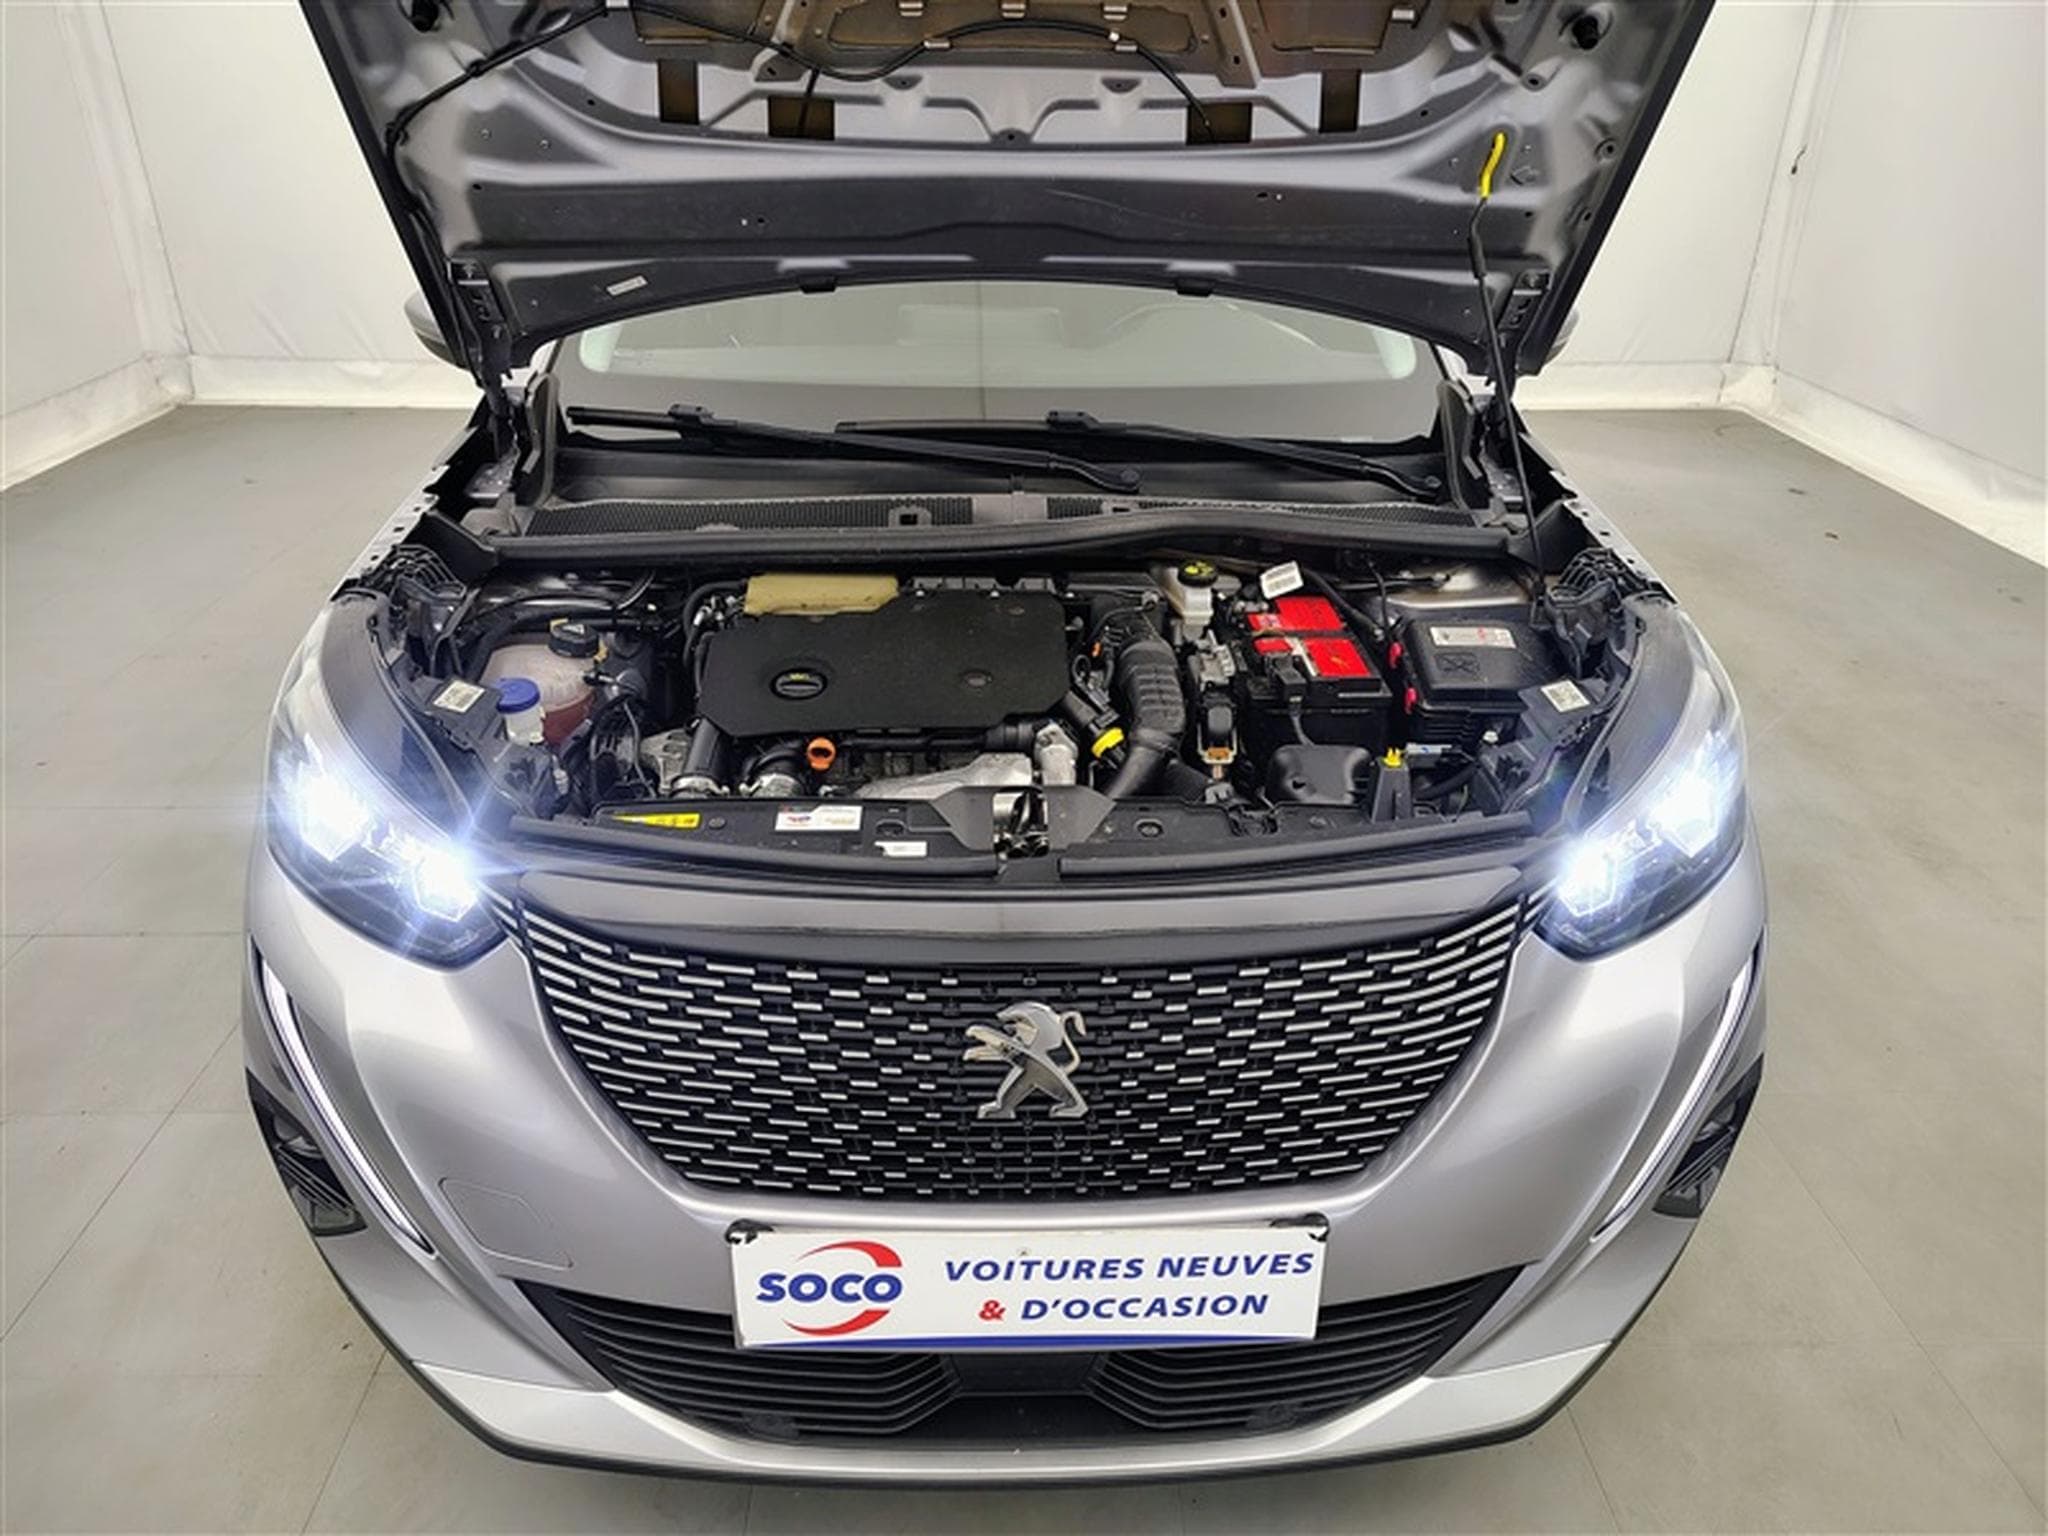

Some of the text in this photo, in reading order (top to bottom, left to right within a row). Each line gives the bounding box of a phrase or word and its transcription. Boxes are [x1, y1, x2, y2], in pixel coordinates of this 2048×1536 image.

[945, 1252, 1315, 1282] VOITURES NEUVES
[756, 1272, 903, 1304] SOCO
[978, 1293, 1269, 1321] & D'OCCASION
